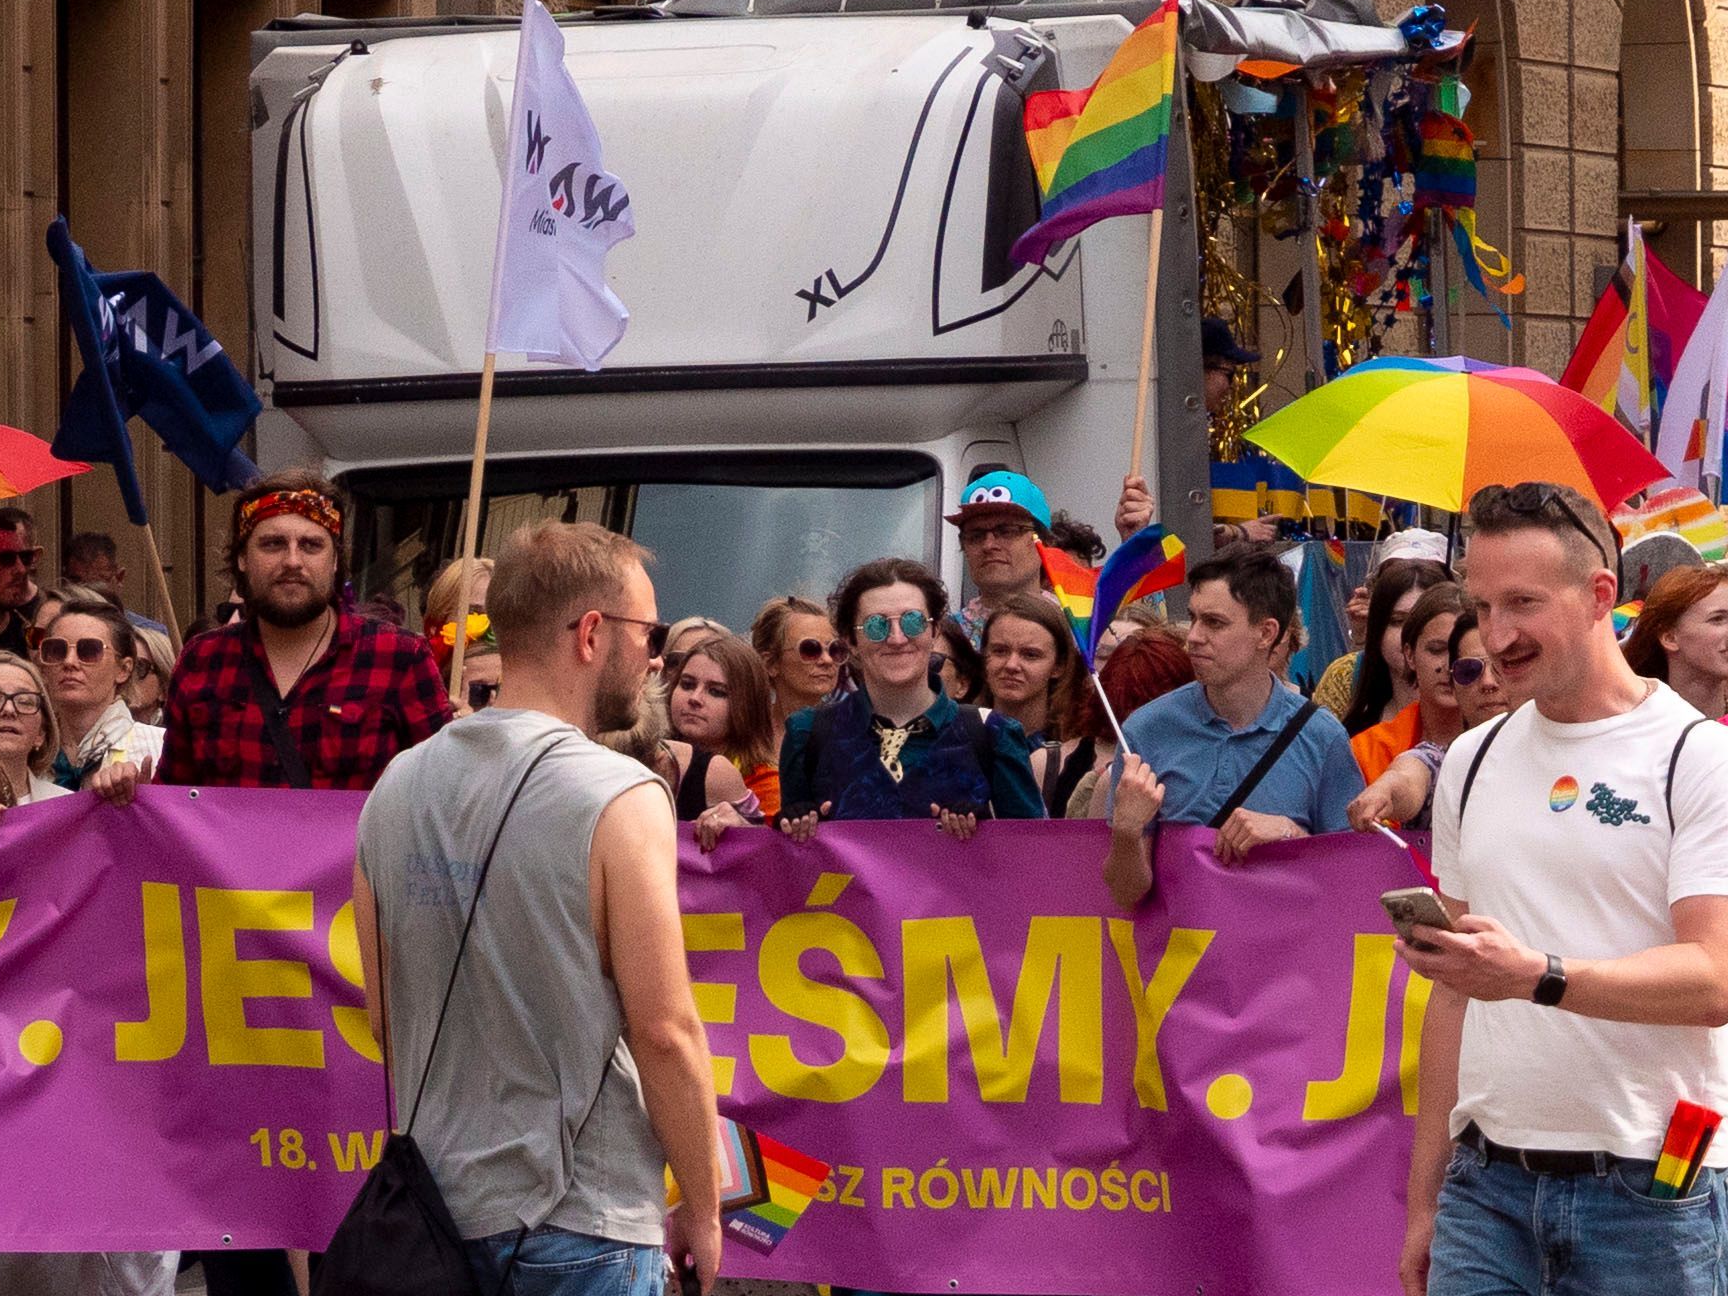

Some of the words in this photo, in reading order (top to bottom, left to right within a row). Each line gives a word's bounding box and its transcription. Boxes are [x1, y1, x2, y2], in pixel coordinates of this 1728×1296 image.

[793, 267, 847, 324] XL
[249, 1127, 318, 1172] 18.
[881, 1158, 1171, 1213] RÓWNOŚCI
